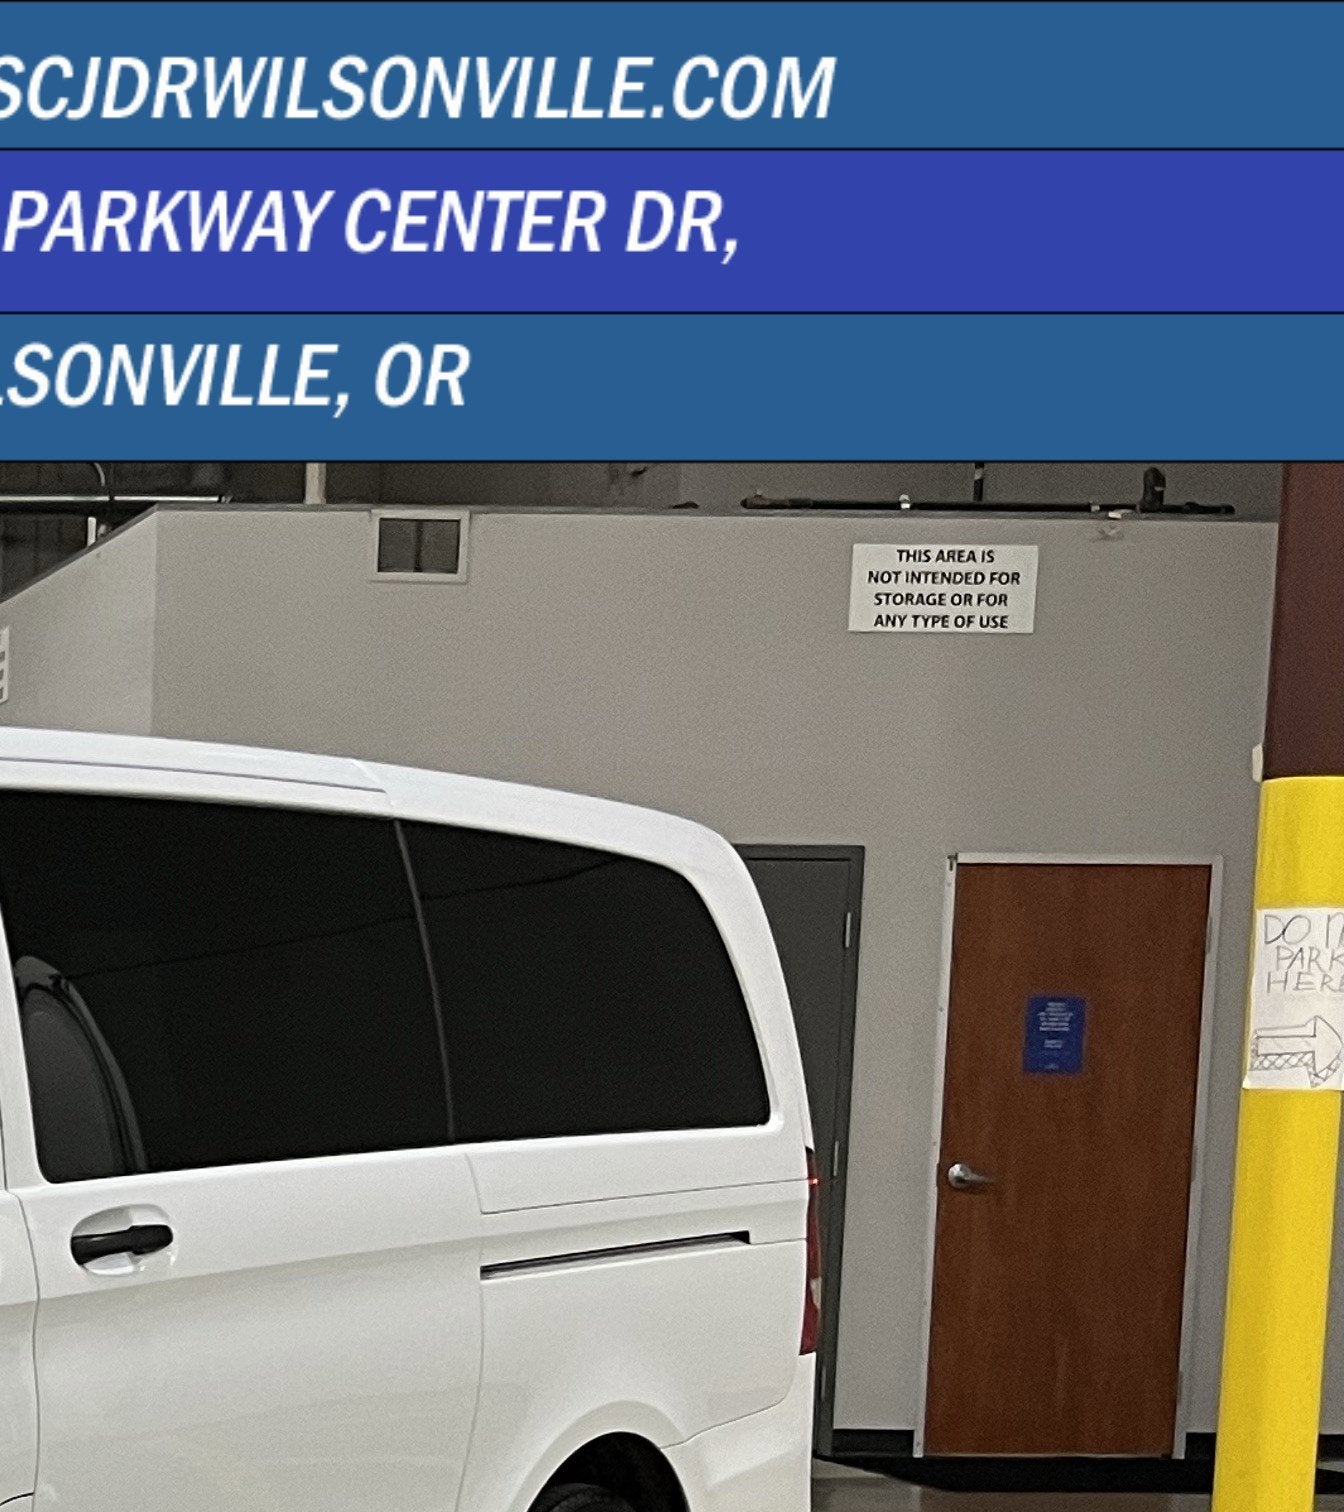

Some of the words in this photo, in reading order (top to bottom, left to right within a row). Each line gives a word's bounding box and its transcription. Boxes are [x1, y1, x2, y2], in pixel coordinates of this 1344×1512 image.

[897, 549, 931, 563] THIS
[935, 549, 977, 563] AREA
[981, 549, 995, 563] IS
[868, 570, 902, 585] NOT
[905, 571, 986, 586] INTENDED
[989, 571, 1021, 586] FOR
[873, 592, 947, 606] STORAGE
[950, 593, 973, 607] OR
[976, 593, 1008, 607] FOR
[873, 614, 908, 628] ANY
[911, 614, 950, 628] TYPE
[953, 615, 976, 629] OF
[979, 615, 1010, 629] USE
[1264, 913, 1312, 945] DO
